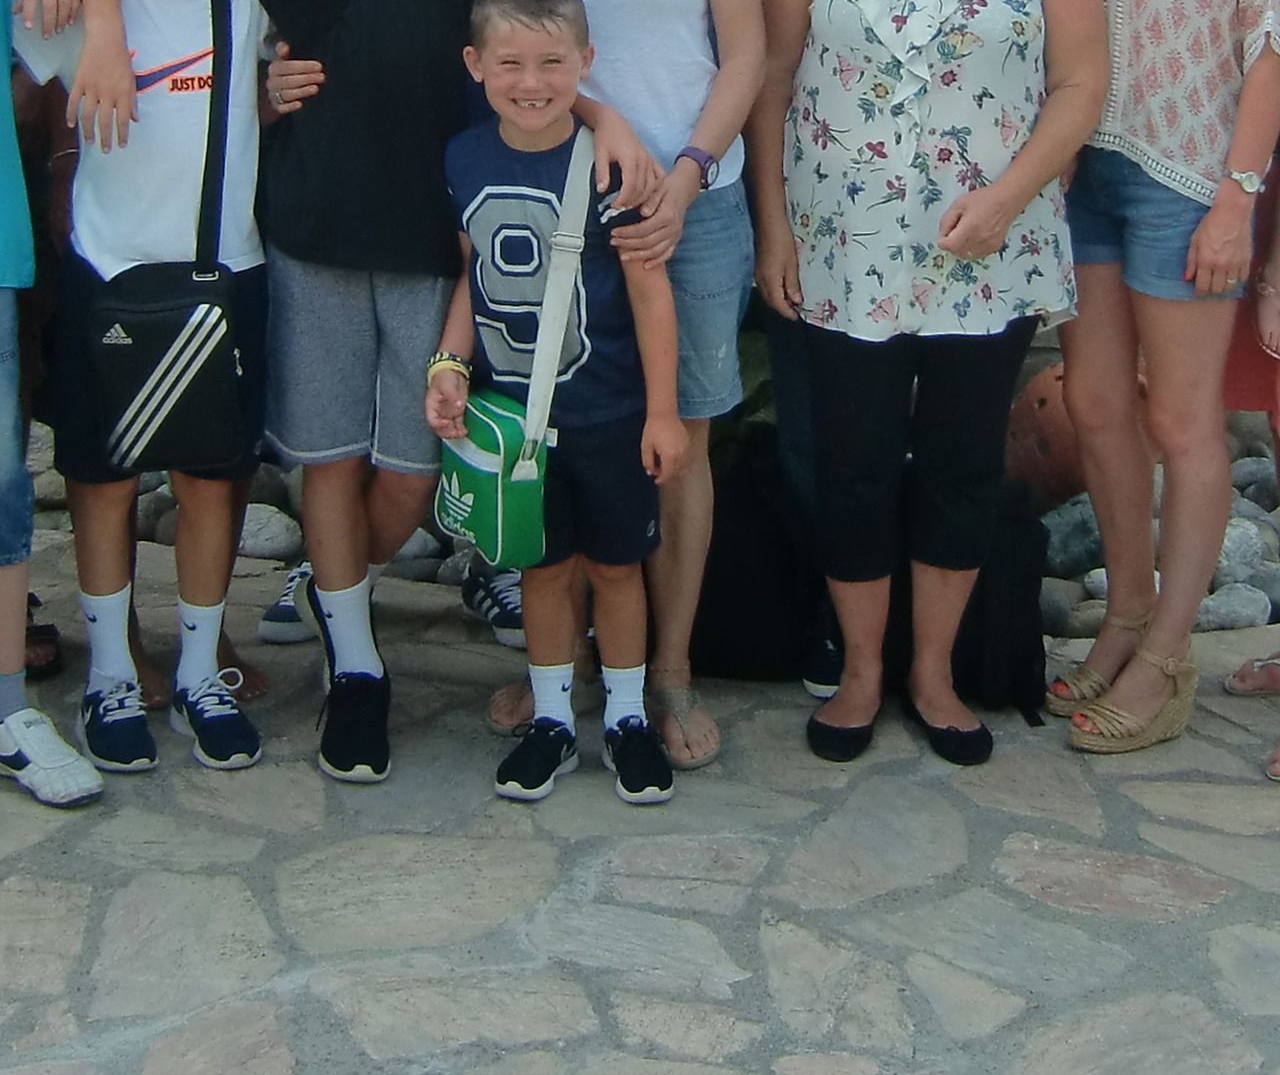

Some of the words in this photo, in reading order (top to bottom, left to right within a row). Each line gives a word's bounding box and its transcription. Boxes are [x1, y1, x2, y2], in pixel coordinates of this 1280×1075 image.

[169, 77, 196, 92] JUST
[197, 75, 215, 90] DO
[462, 185, 591, 383] 9
